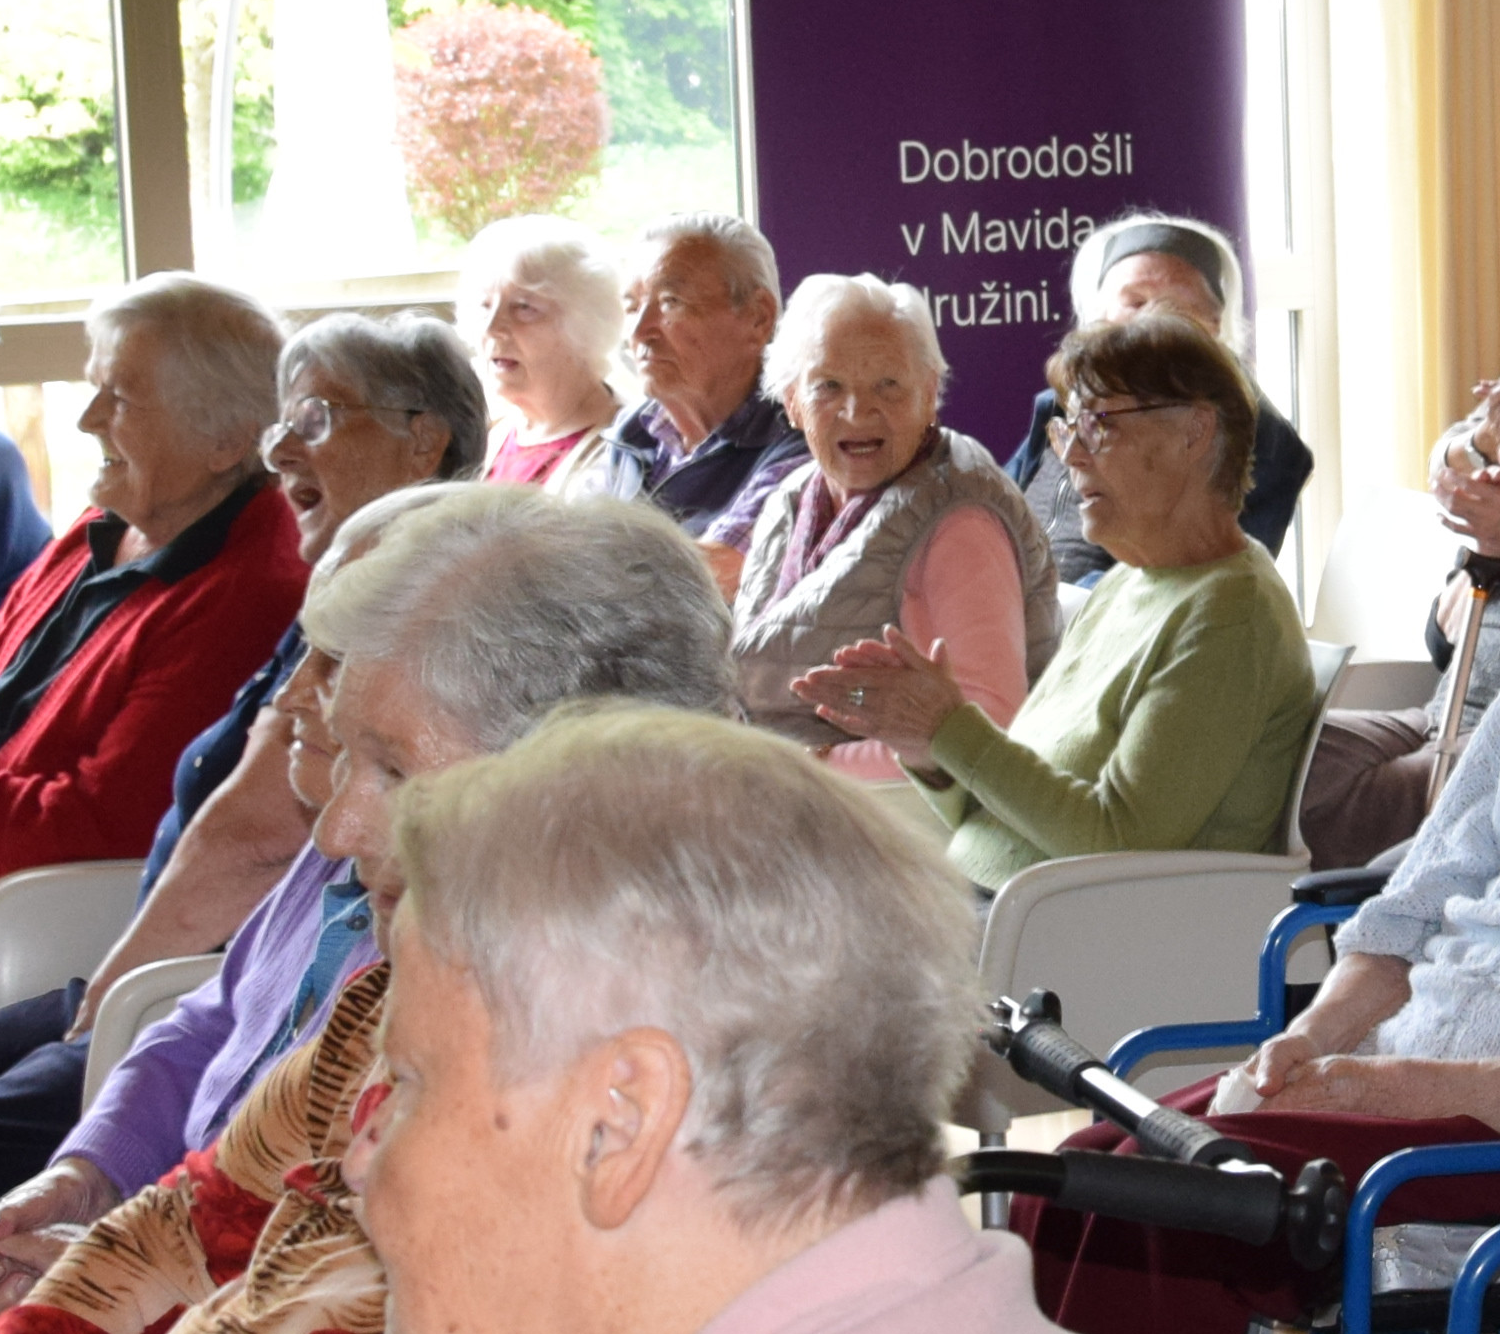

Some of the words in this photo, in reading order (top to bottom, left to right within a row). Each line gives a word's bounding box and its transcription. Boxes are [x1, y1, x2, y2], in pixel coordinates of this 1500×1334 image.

[899, 132, 1134, 184] Dobrodošli
[901, 223, 925, 256] v
[942, 207, 1095, 255] Mavida
[923, 280, 1060, 328] ružini.
